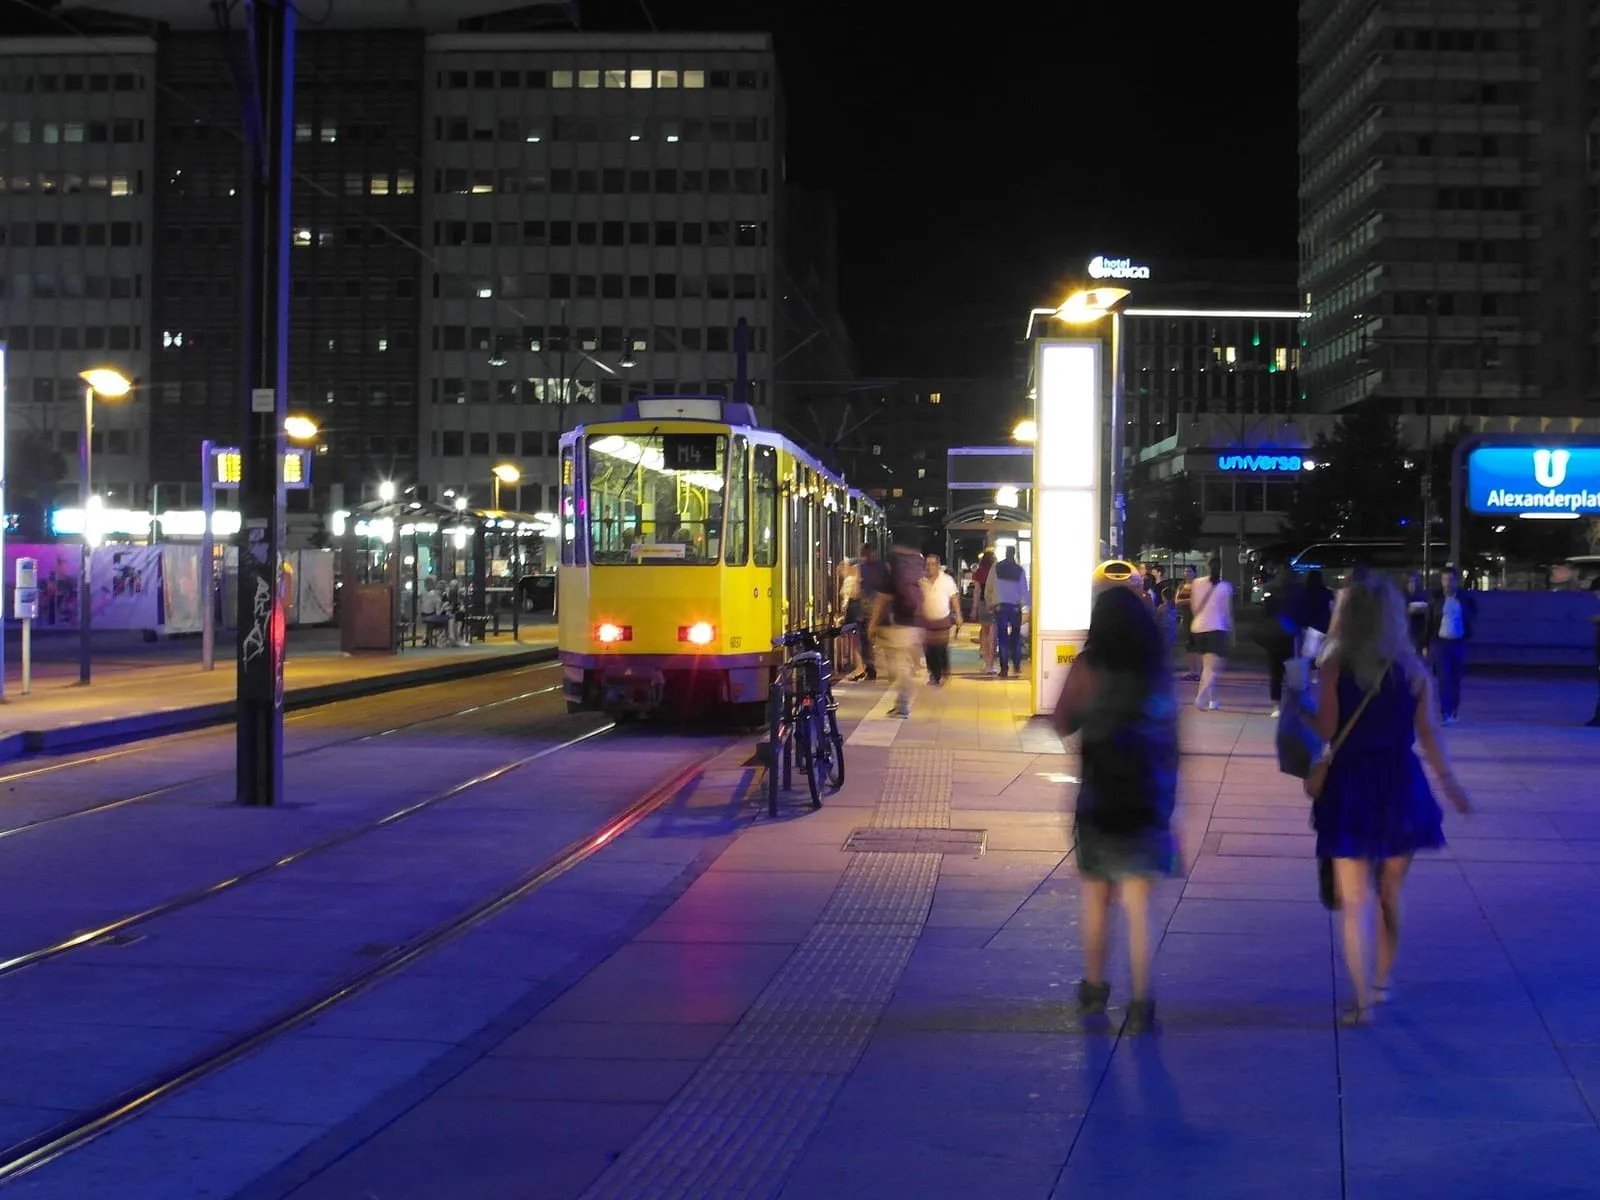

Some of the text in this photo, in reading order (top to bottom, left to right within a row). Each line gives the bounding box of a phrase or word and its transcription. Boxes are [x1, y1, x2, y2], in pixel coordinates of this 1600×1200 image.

[1103, 258, 1130, 268] hotel
[677, 444, 701, 463] M4
[1219, 455, 1301, 471] universa
[1533, 449, 1571, 488] U
[1057, 655, 1075, 664] BVG
